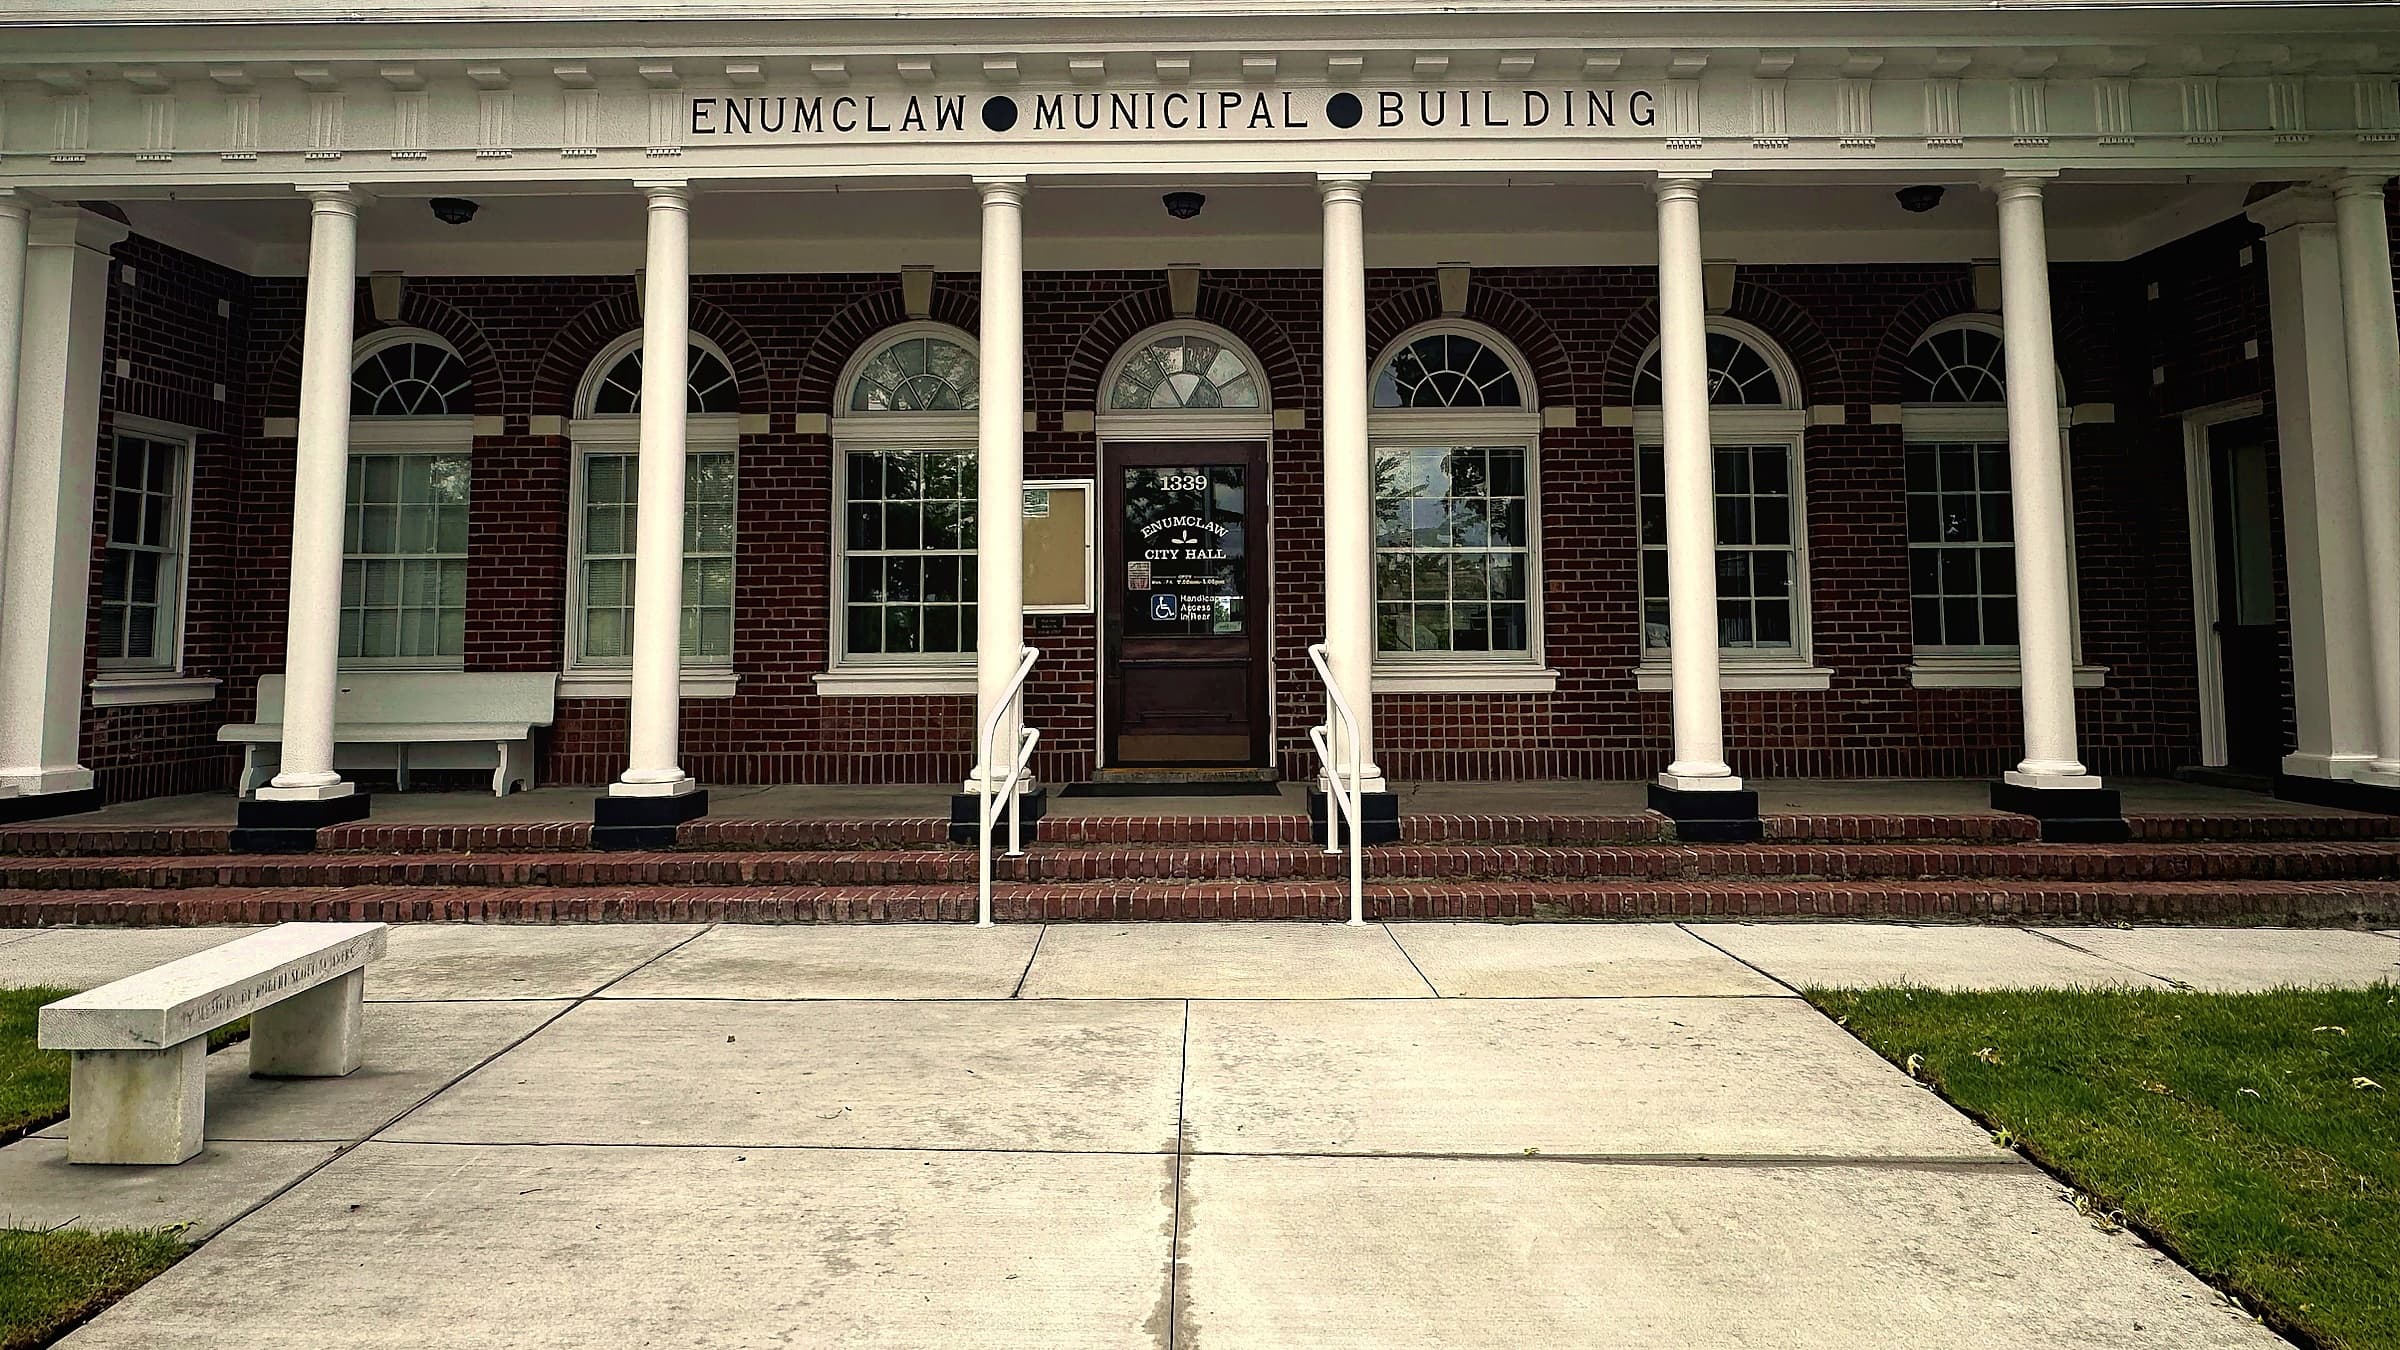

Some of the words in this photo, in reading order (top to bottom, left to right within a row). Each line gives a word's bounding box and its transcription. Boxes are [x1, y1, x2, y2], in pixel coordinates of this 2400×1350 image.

[691, 95, 967, 134] ENUMCLAW
[1033, 91, 1308, 130] MUNICIPAL
[1377, 90, 1655, 127] BUILDING
[1160, 475, 1208, 491] 1339
[1140, 516, 1228, 539] ENUMCLAW
[1144, 549, 1179, 560] CITY
[1185, 549, 1227, 560] HALL
[1180, 604, 1211, 612] Access
[1190, 612, 1211, 621] Rear
